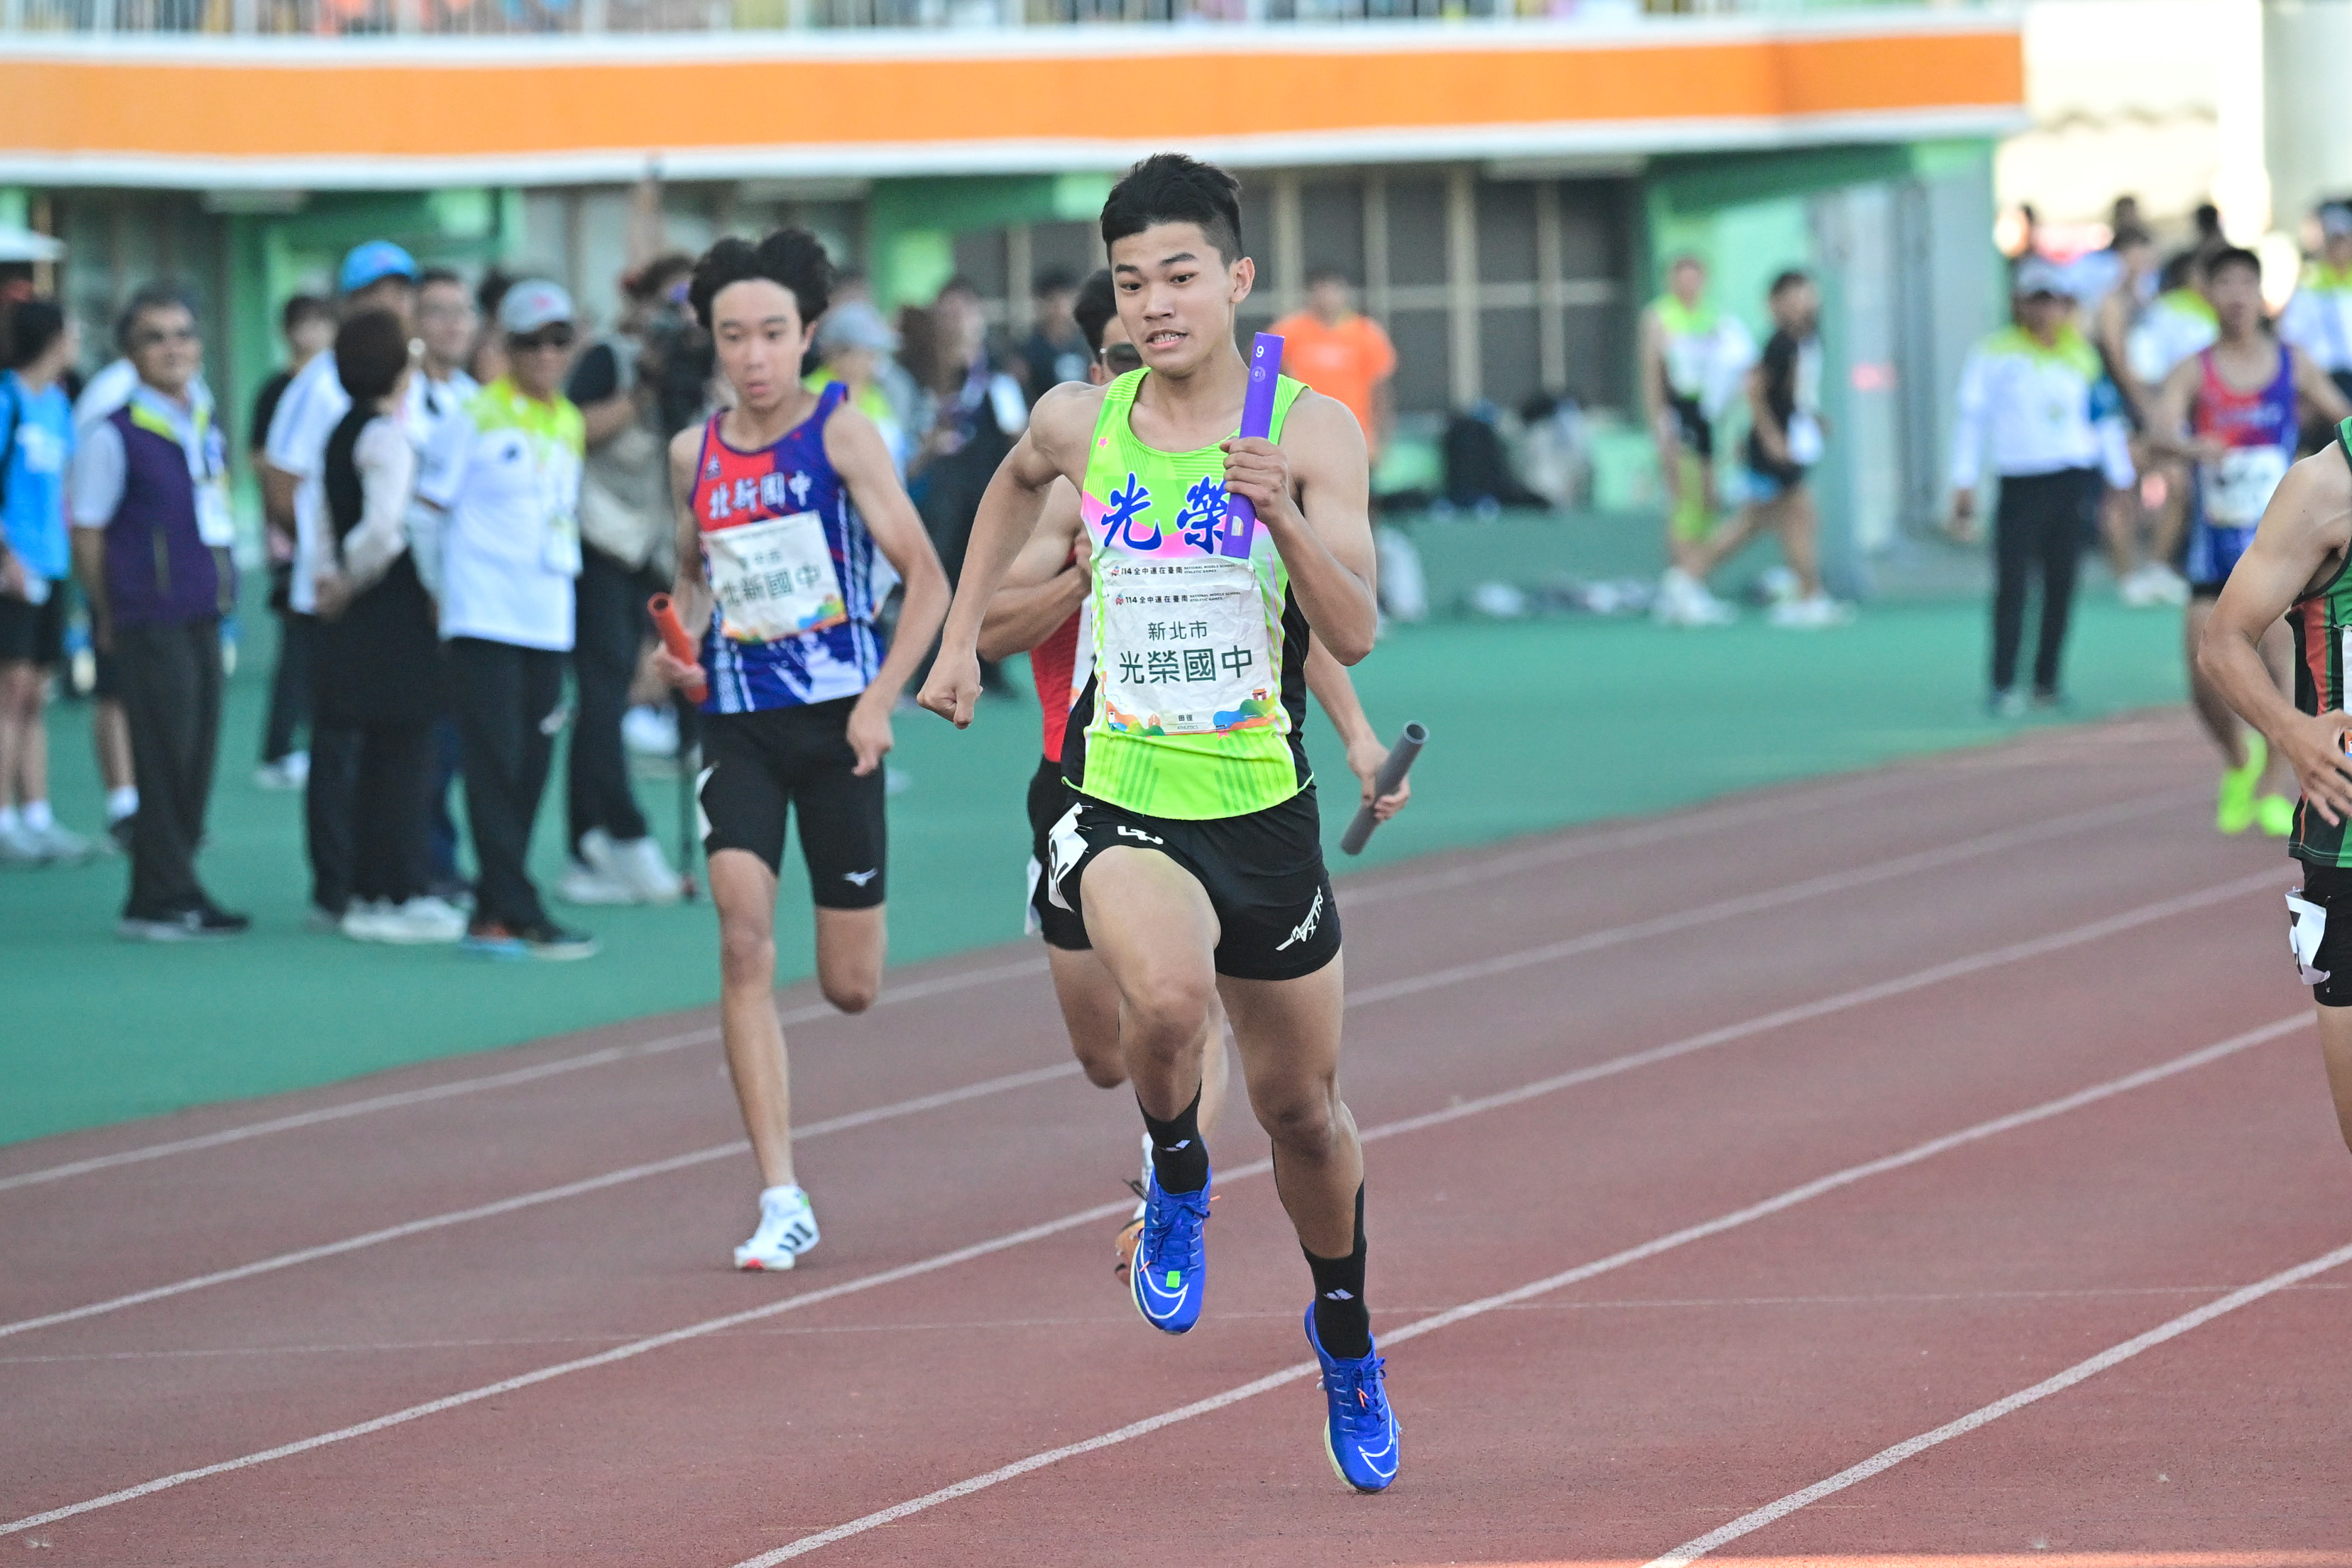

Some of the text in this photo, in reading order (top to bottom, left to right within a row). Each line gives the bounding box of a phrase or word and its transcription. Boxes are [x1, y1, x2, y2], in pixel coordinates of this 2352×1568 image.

[1255, 345, 1264, 358] 9
[1100, 472, 1228, 554] 光榮
[1147, 620, 1208, 641] 新北市
[1119, 645, 1253, 684] 光榮國中
